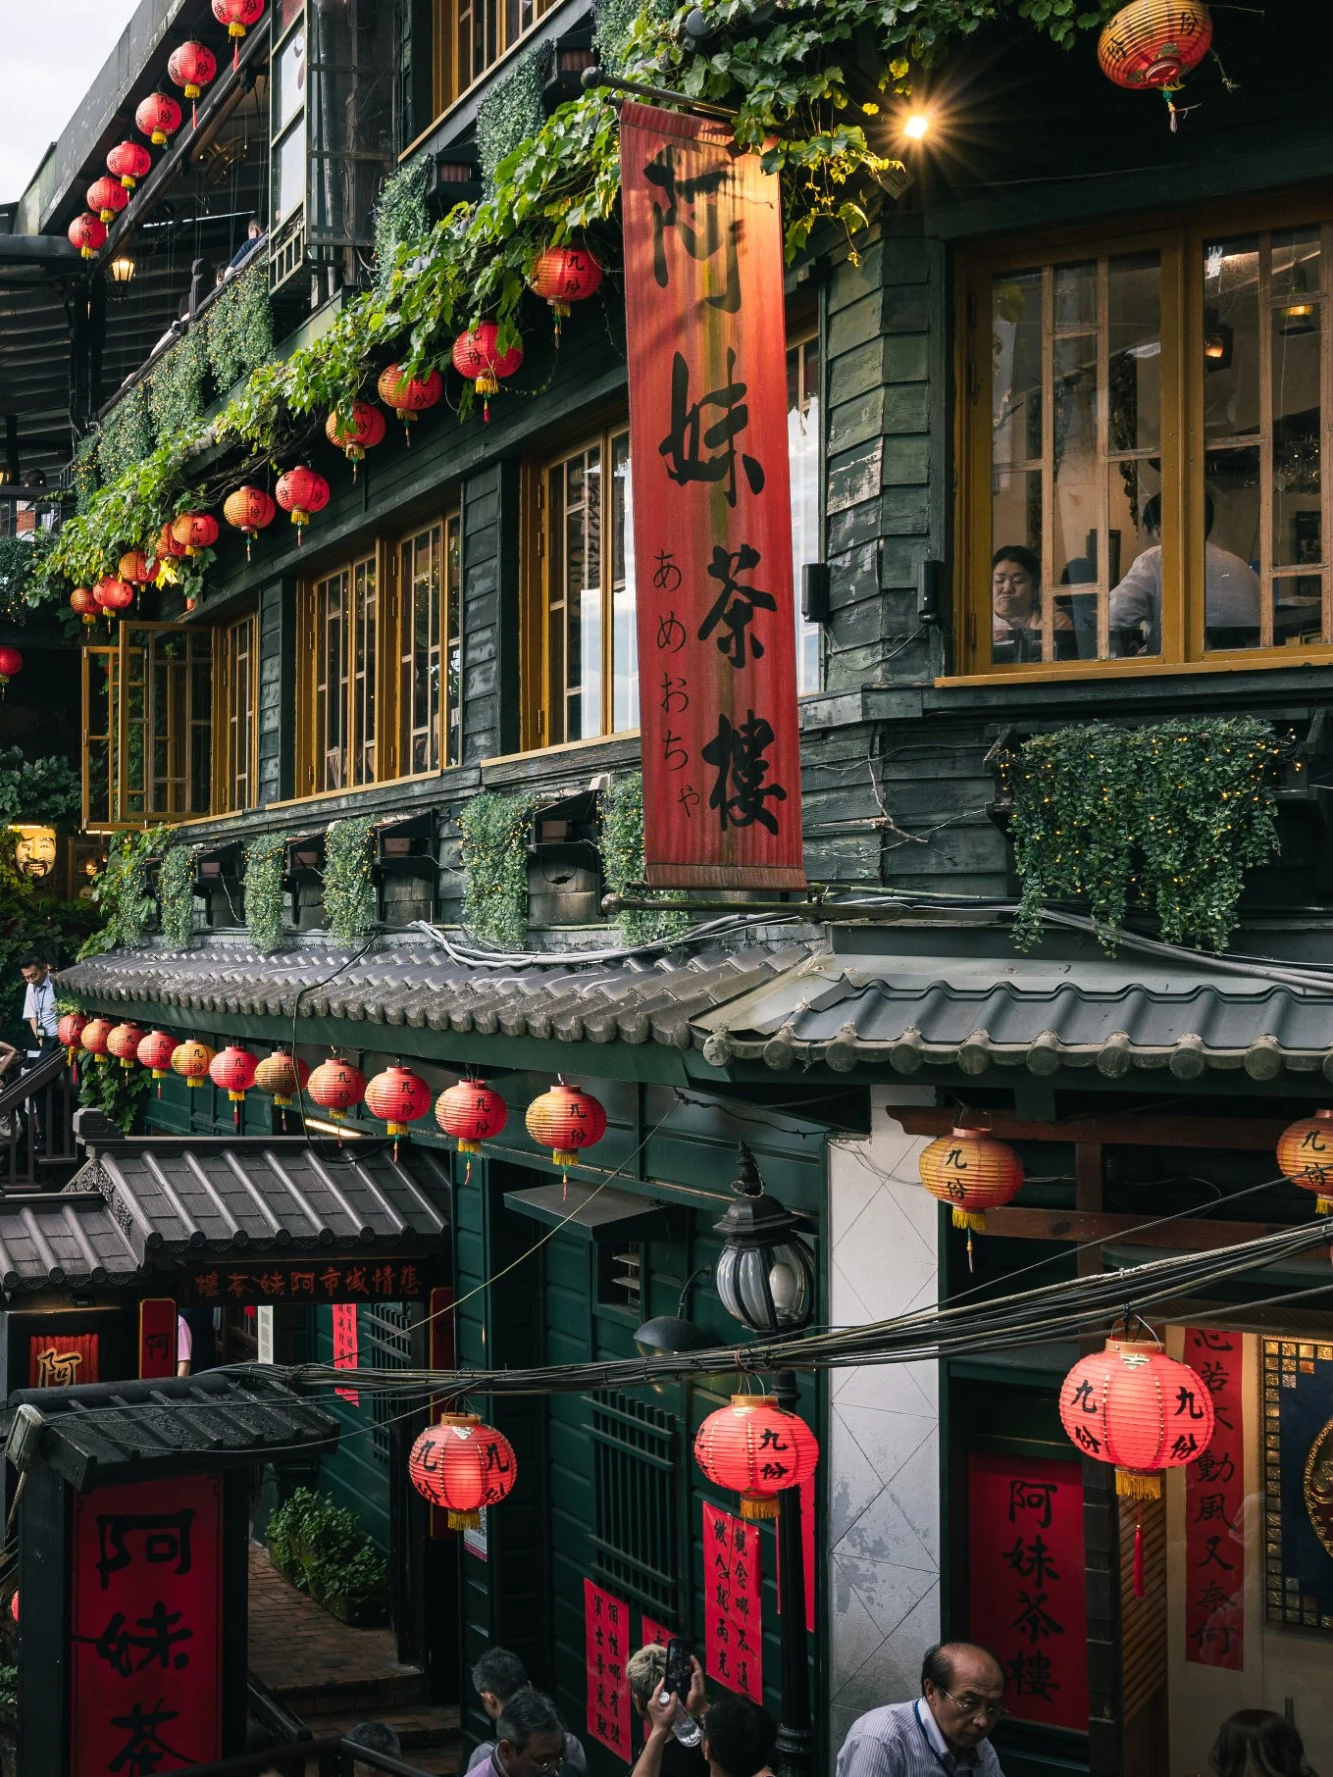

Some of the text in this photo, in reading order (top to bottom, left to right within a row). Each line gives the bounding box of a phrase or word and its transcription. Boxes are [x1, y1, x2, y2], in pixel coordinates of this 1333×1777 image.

[566, 255, 584, 294] 九份
[249, 491, 261, 519] 九份
[193, 1048, 205, 1073] 九份
[235, 1057, 246, 1085] 九份
[338, 1071, 351, 1103] 九份
[401, 1081, 415, 1116] 九份
[475, 1096, 491, 1136] 九份
[569, 1103, 587, 1144] 九份
[946, 1148, 967, 1200] 九份
[1070, 1379, 1101, 1454] 九份
[1172, 1386, 1204, 1461] 九份
[759, 1428, 789, 1480] 九份
[1002, 1480, 1064, 1703] 阿妹茶樓
